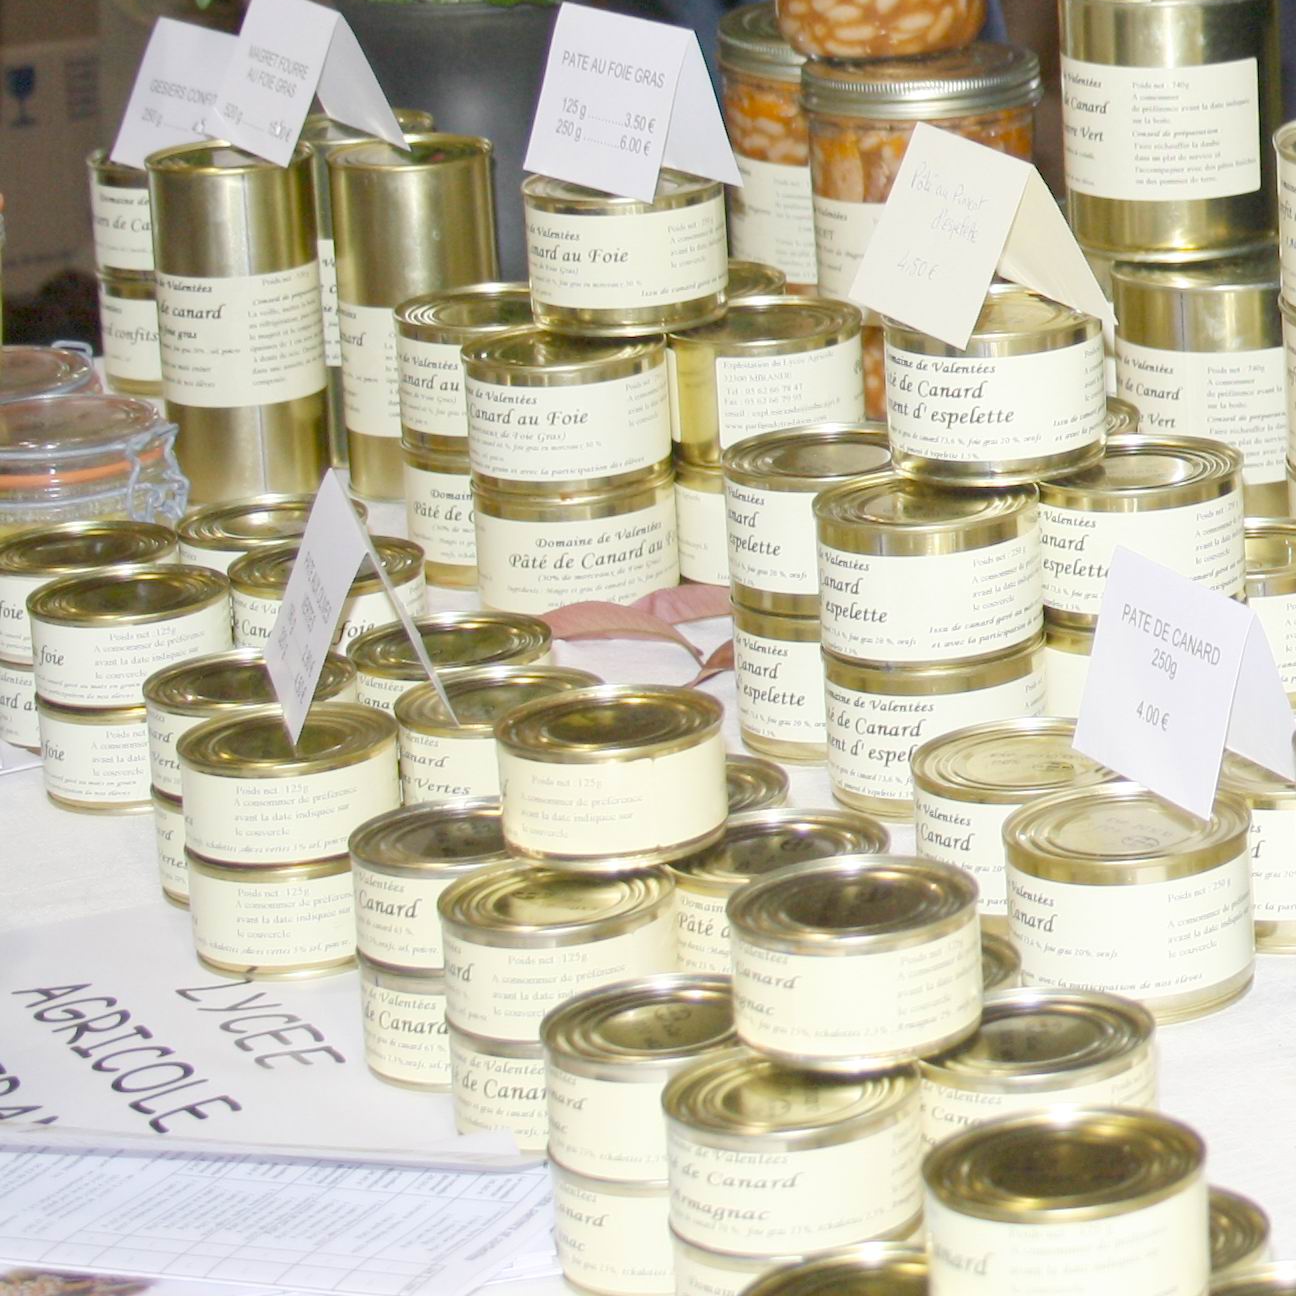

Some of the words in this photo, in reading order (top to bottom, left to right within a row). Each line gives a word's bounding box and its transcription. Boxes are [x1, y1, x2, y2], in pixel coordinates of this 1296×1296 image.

[560, 50, 590, 72] PATE
[590, 60, 606, 75] AU
[608, 62, 633, 82] FOIE
[634, 68, 665, 89] GRAS
[562, 97, 579, 116] 125
[579, 104, 587, 120] g
[624, 112, 646, 132] 3.50
[647, 118, 657, 135] €
[555, 120, 574, 137] 250
[575, 128, 582, 142] g
[619, 134, 642, 154] 6.00
[643, 140, 652, 157] €
[562, 252, 582, 263] au
[588, 247, 629, 264] Foie
[172, 304, 226, 320] canard
[900, 376, 913, 392] de
[918, 380, 988, 400] Canard
[1149, 414, 1176, 430] Vert
[509, 553, 547, 570] Pâté
[553, 554, 572, 570] de
[581, 546, 643, 570] Canard
[825, 601, 889, 625] espelette
[1121, 603, 1150, 633] PATE
[1153, 621, 1170, 642] DE
[1171, 628, 1222, 666] CANARD
[39, 646, 65, 668] foie
[1151, 647, 1178, 681] 250g
[743, 682, 806, 707] espelette
[1136, 700, 1160, 725] 4.00
[1161, 712, 1170, 732] €
[855, 719, 927, 739] Canard
[416, 776, 472, 796] Vertes
[920, 823, 976, 852] Canard
[174, 977, 347, 1070] LYCEE
[11, 982, 243, 1134] AGRICOLE
